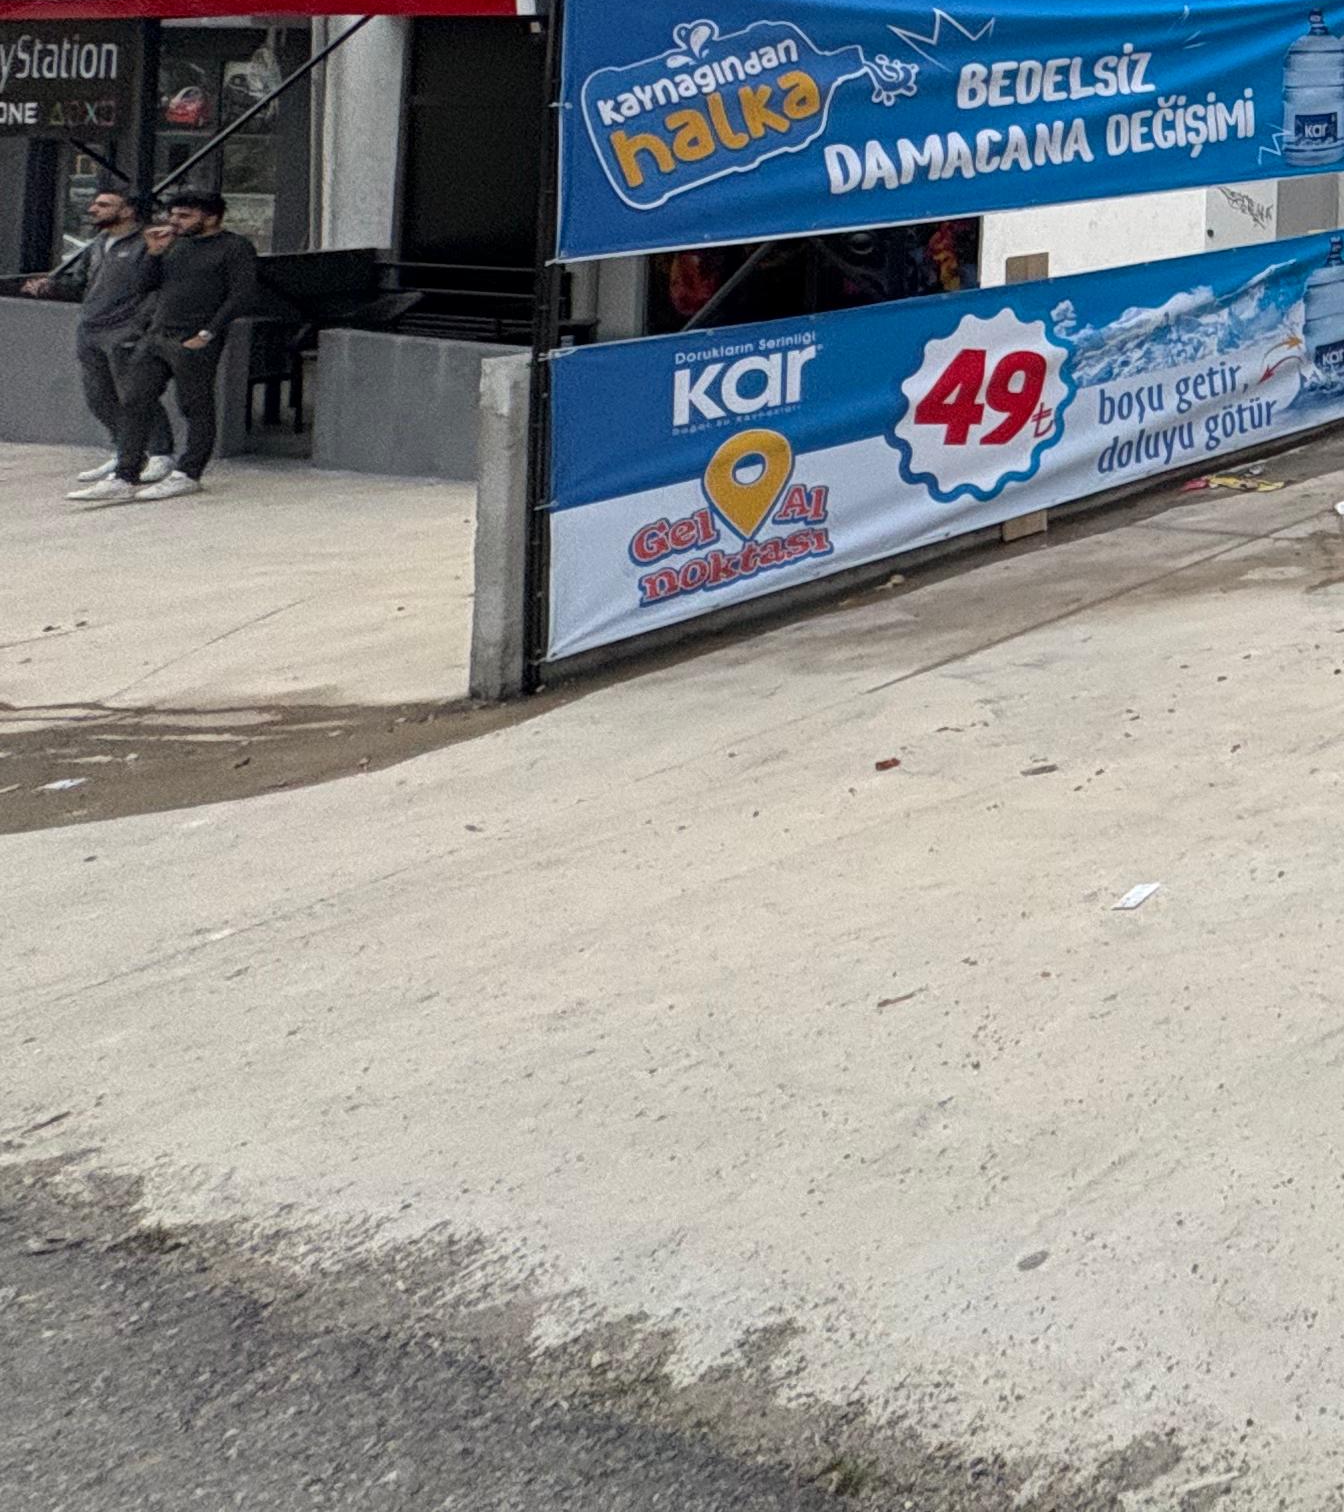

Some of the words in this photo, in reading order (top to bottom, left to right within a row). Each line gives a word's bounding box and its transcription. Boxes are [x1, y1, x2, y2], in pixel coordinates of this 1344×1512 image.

[957, 42, 1156, 109] BEDELSİZ
[609, 71, 822, 188] halka
[824, 117, 1094, 195] DAMACANA
[1105, 88, 1256, 158] DEĞİŞİMİ
[672, 345, 817, 427] kar
[1099, 384, 1164, 425] boşu
[1175, 362, 1248, 414] getir,
[1098, 421, 1194, 474] doluyu
[1205, 397, 1277, 451] götür
[630, 508, 717, 566] Gel
[774, 484, 829, 524] Al
[640, 528, 834, 607] noktası
